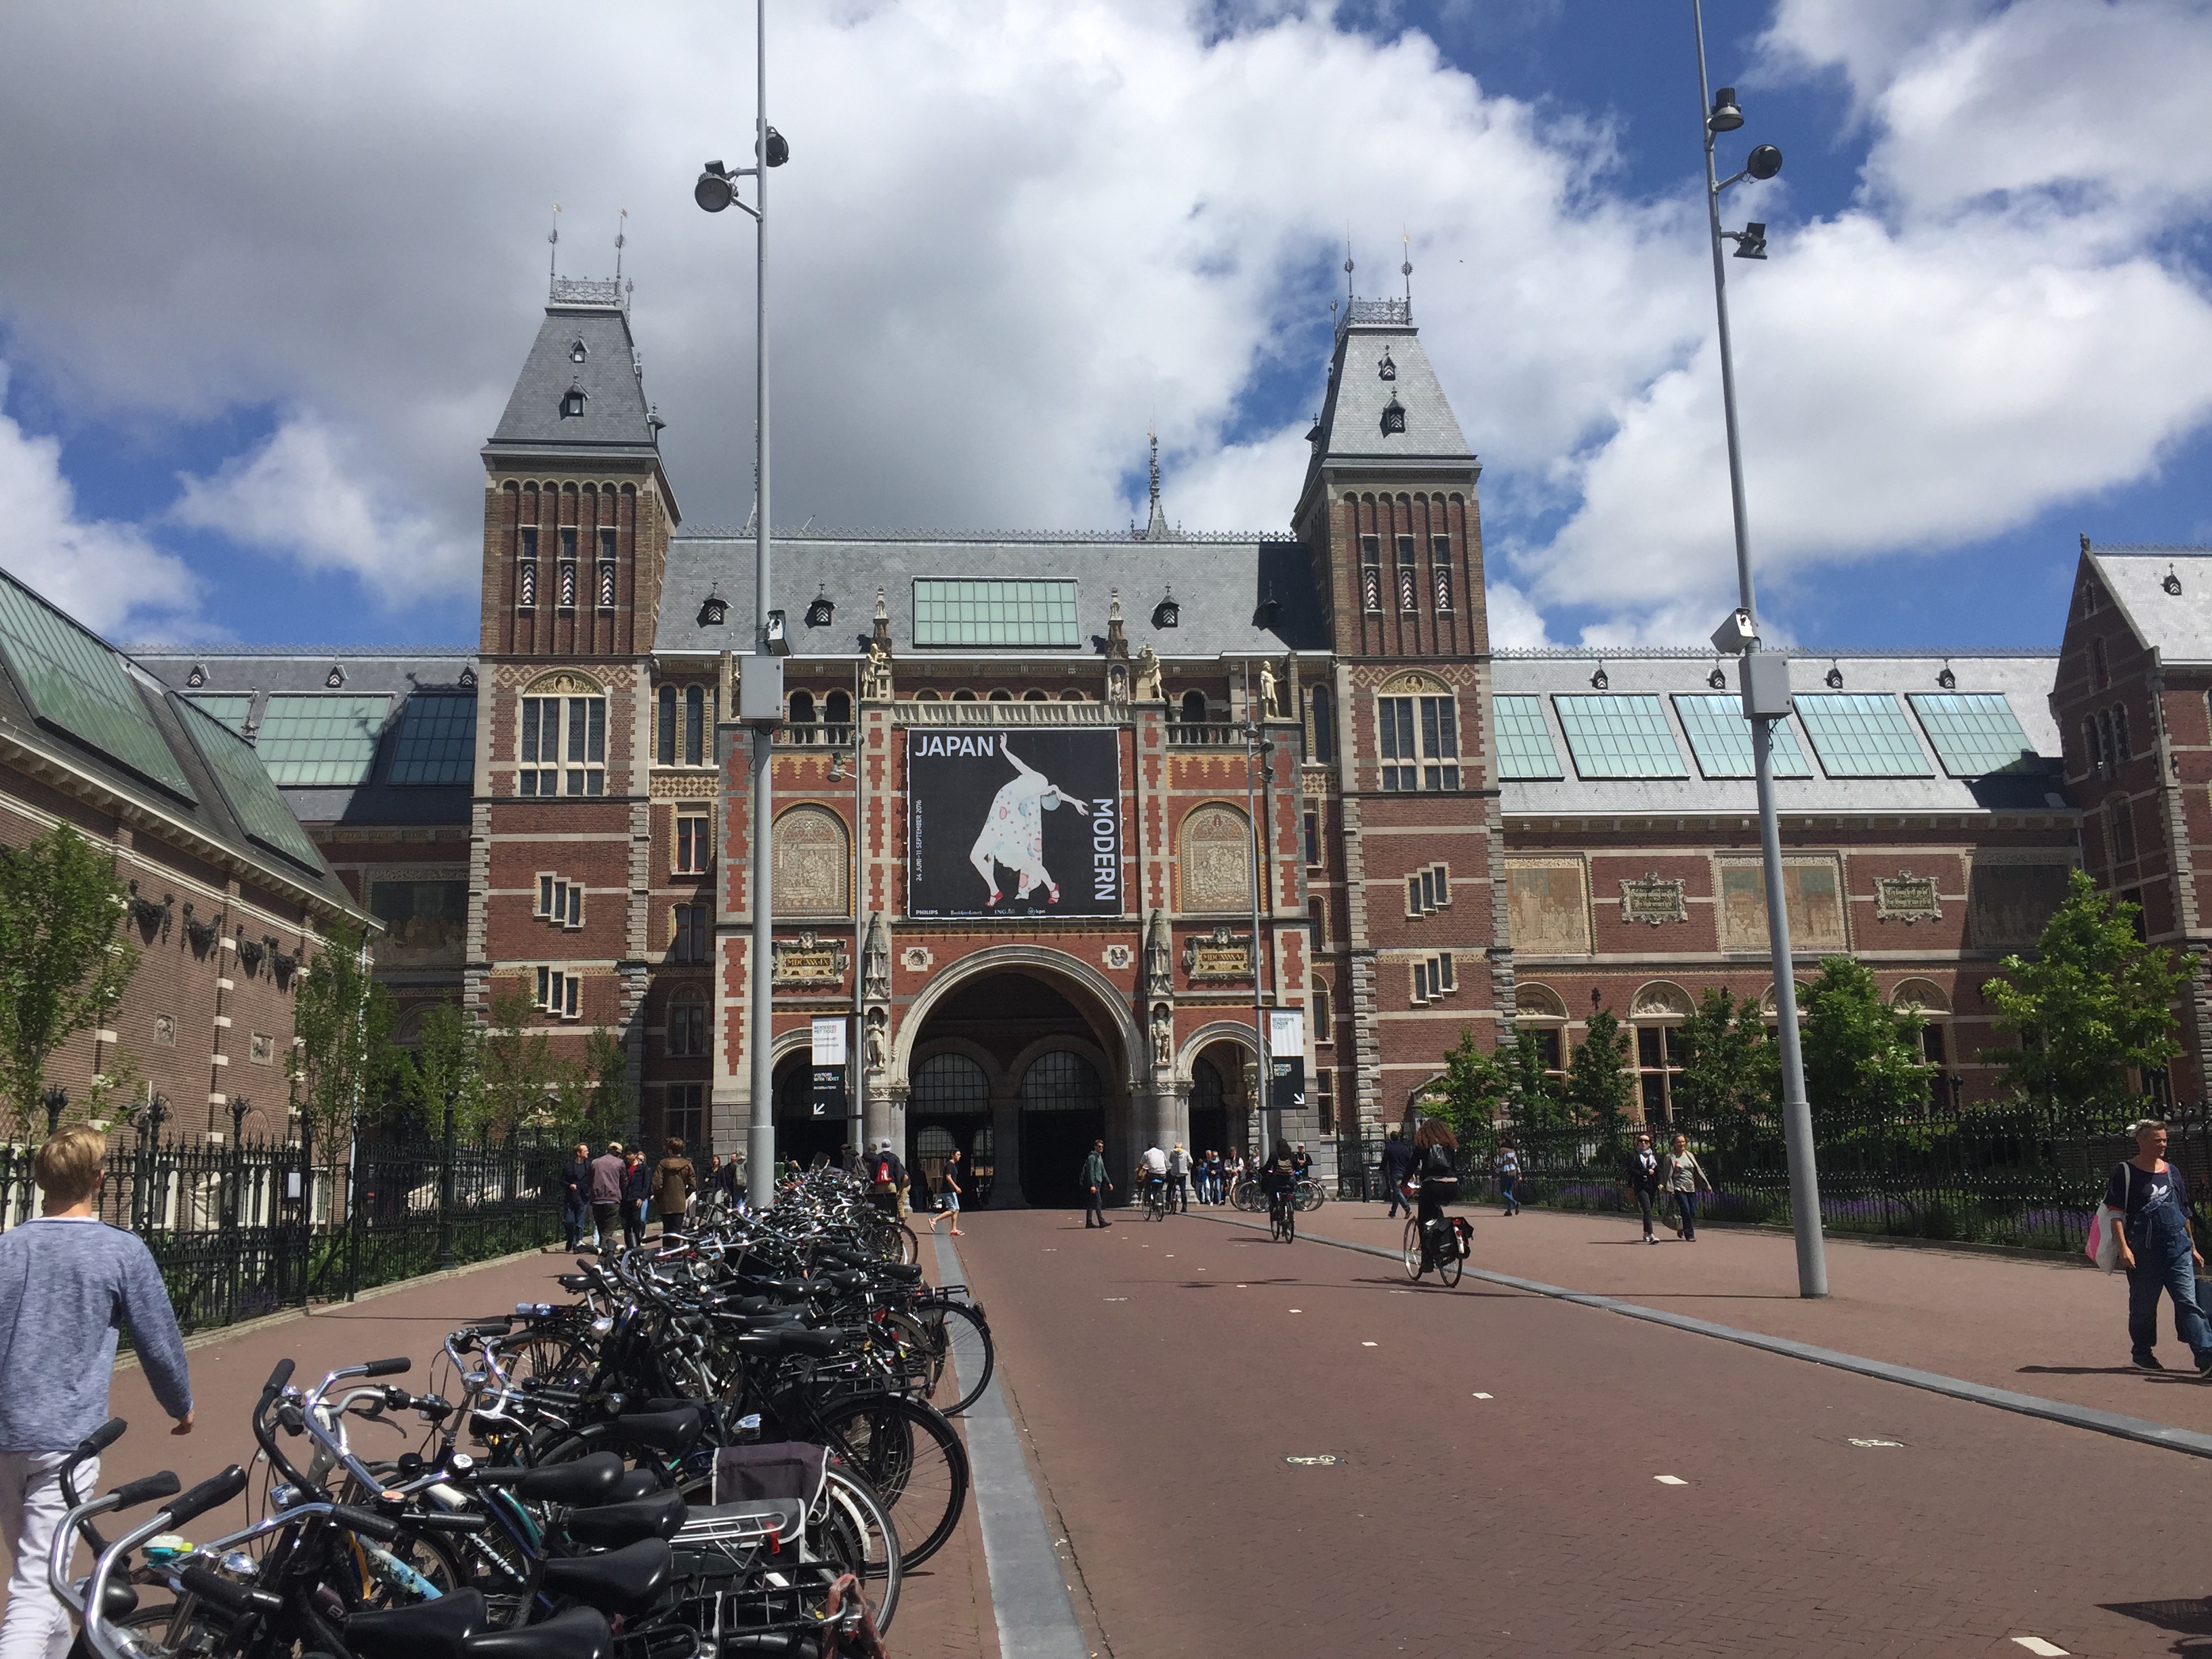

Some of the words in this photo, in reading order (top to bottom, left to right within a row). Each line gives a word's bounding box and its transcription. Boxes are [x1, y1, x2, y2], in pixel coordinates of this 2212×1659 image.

[915, 736, 994, 757] JAPAN
[1092, 798, 1116, 900] MODERN
[916, 873, 922, 881] 24
